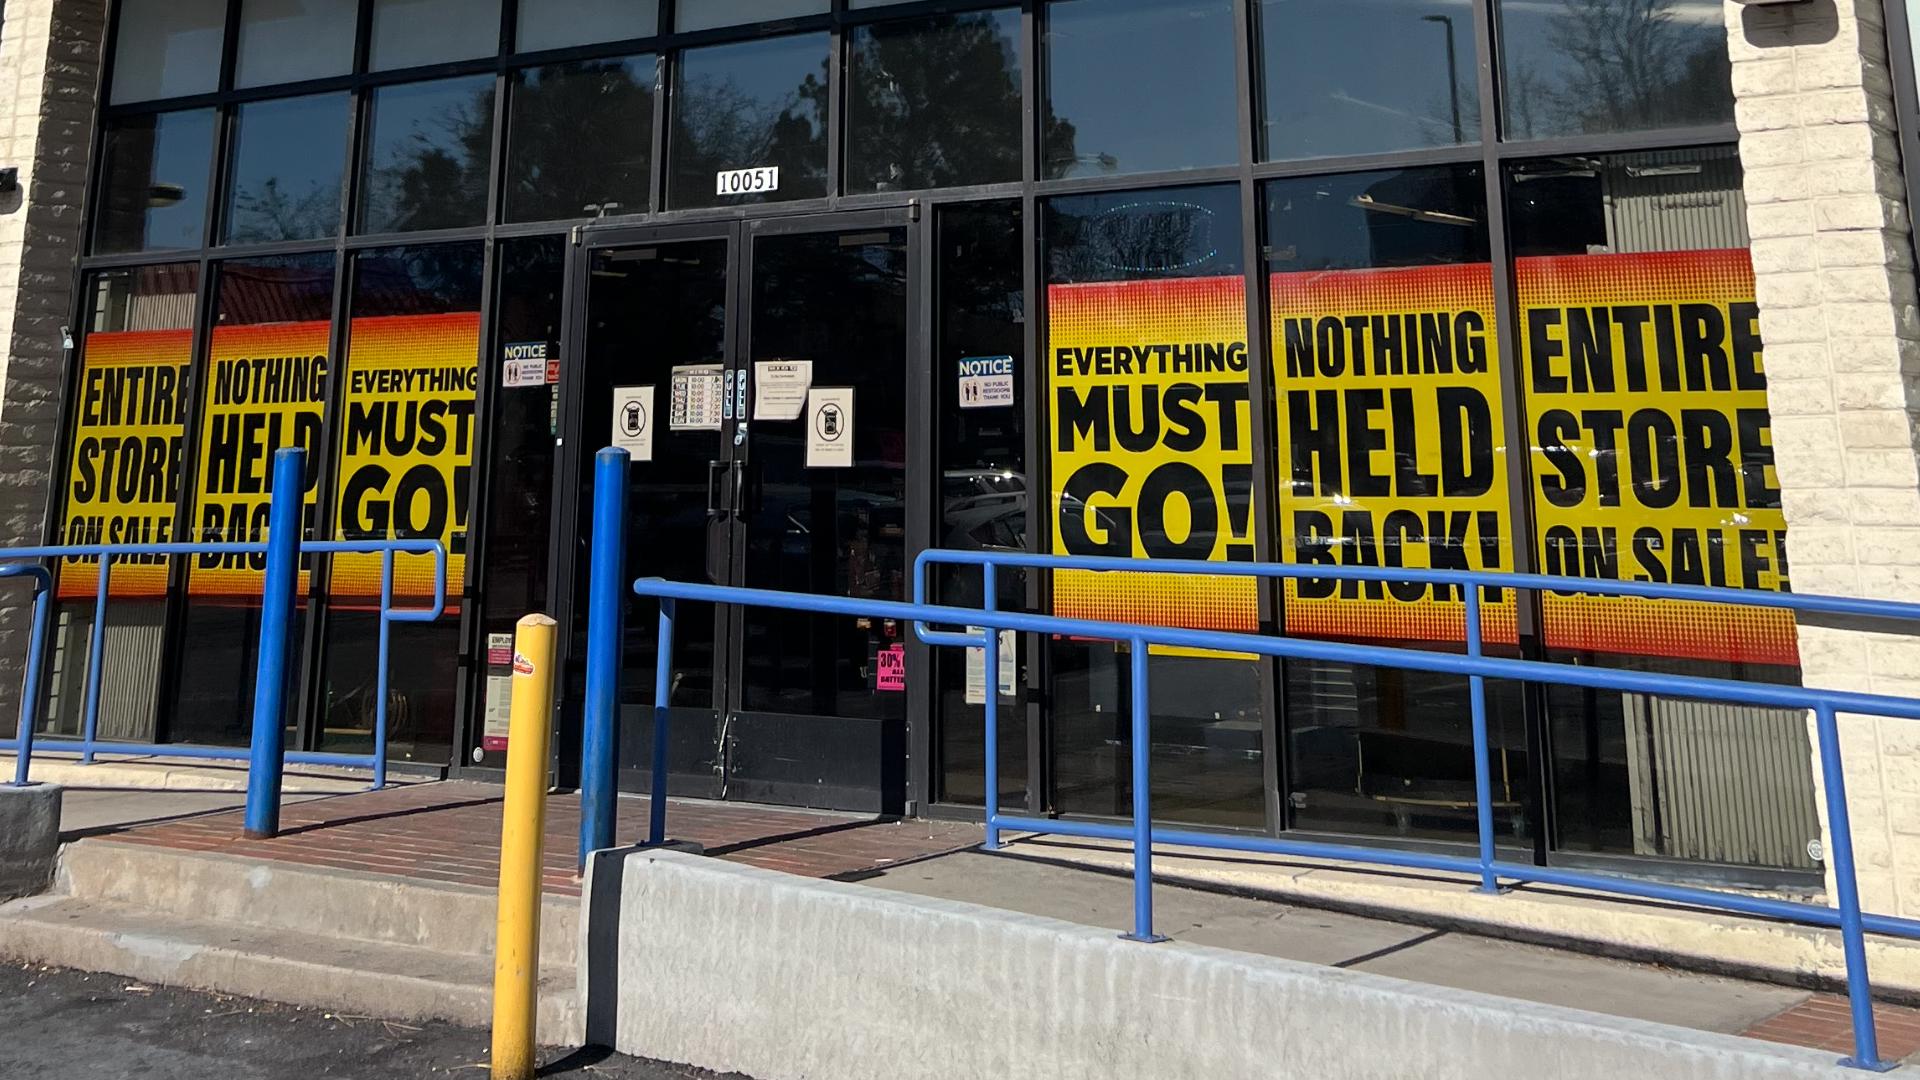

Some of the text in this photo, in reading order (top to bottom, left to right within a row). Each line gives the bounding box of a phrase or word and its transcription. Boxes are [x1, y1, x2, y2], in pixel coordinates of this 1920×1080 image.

[721, 169, 774, 193] 10051
[504, 344, 547, 359] NOTICE
[959, 359, 1012, 376] NOTICE
[1056, 342, 1248, 377] EVERYTHING
[1284, 310, 1488, 378] NOTHING
[1527, 302, 1768, 393] ENTIRE
[81, 365, 191, 427] ENTIRE
[214, 355, 327, 405] NOTHING
[351, 367, 478, 394] EVERYTHING
[346, 399, 475, 456] MUST
[1056, 382, 1249, 453] MUST
[1287, 386, 1494, 498] HELD
[74, 436, 182, 504] STORE
[1537, 408, 1782, 509] STORE
[67, 515, 104, 564] ON
[341, 464, 470, 554] GO!
[1059, 462, 1254, 571] GO!
[1294, 509, 1503, 603] BACK!
[1545, 525, 1620, 598] ON
[880, 653, 900, 668] 30%
